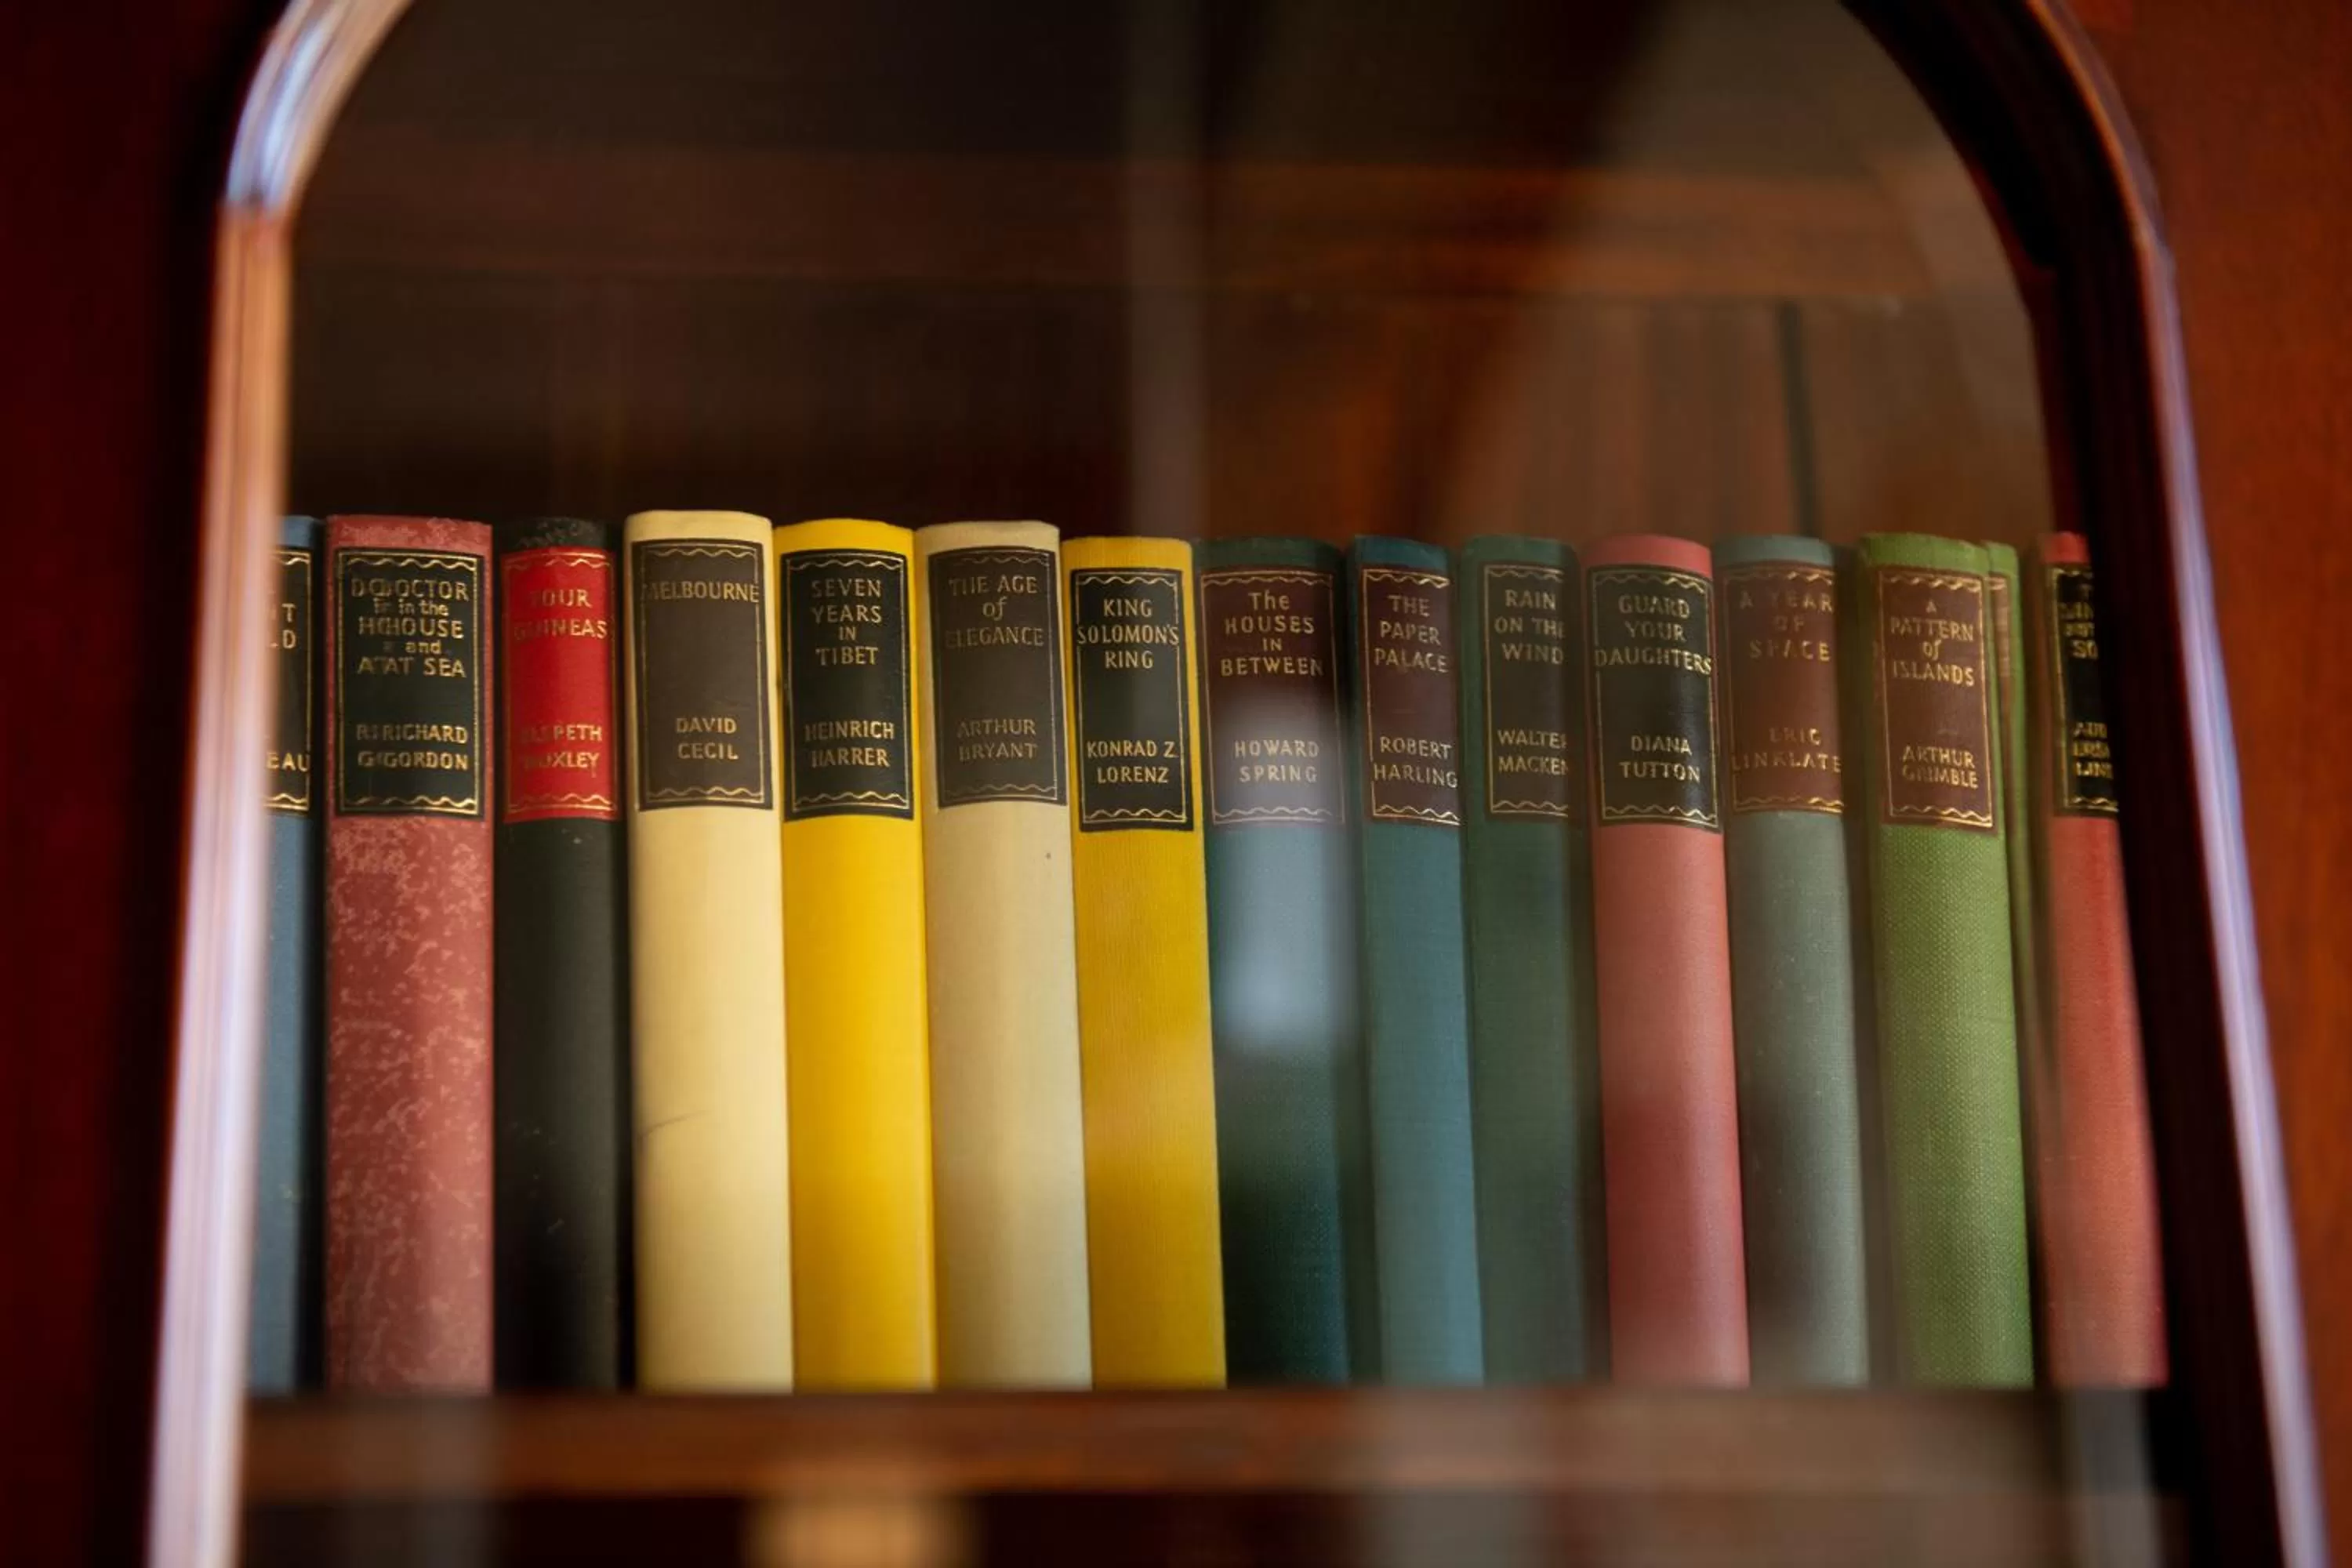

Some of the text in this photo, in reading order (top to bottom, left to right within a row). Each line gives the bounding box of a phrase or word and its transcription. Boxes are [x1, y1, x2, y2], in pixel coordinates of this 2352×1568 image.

[811, 578, 882, 599] SEVEN
[949, 574, 1038, 597] THE AGE
[419, 600, 449, 616] the
[982, 596, 1007, 621] of
[1102, 598, 1153, 618] KING
[1248, 590, 1290, 611] The
[1387, 594, 1431, 617] THE
[1504, 590, 1556, 611] RAIN
[1618, 594, 1691, 619] GUARD
[1925, 598, 1938, 614] A
[811, 605, 883, 625] YEARS
[1224, 615, 1316, 635] HOUSES
[1494, 616, 1523, 634] ON
[839, 626, 857, 641] IN
[945, 626, 1044, 648] ELEGANCE
[1076, 623, 1179, 645] SOLOMON'S
[1380, 620, 1442, 645] PAPER
[1624, 621, 1686, 641] YOUR
[1889, 617, 1974, 643] PATTERN
[405, 640, 442, 655] and
[1262, 638, 1283, 652] IN
[1501, 642, 1563, 665] WIND
[1922, 638, 1943, 662] of
[815, 646, 879, 666] TIBET
[1104, 650, 1154, 670] RING
[1374, 648, 1450, 673] PALACE
[1595, 646, 1712, 675] DAUGHTERS
[423, 657, 467, 678] SEA
[1220, 657, 1323, 677] BETWEEN
[1892, 661, 1975, 688] ISLANDS
[675, 717, 737, 734] DAVID
[804, 720, 895, 742] HEINRICH
[957, 718, 1036, 738] ARTHUR
[677, 742, 739, 760] CECIL
[958, 743, 1038, 762] BRYANT
[1087, 741, 1157, 758] KONRAD
[1234, 739, 1320, 759] HOWARD
[1380, 736, 1452, 760] ROBERT
[1631, 734, 1692, 756] DIANA
[811, 747, 890, 768] HARRER
[1902, 746, 1976, 769] ARTHUR
[1097, 766, 1170, 784] LORENZ
[1239, 765, 1318, 783] SPRING
[1374, 763, 1458, 789] HARLING
[1618, 760, 1701, 783] TUTTON
